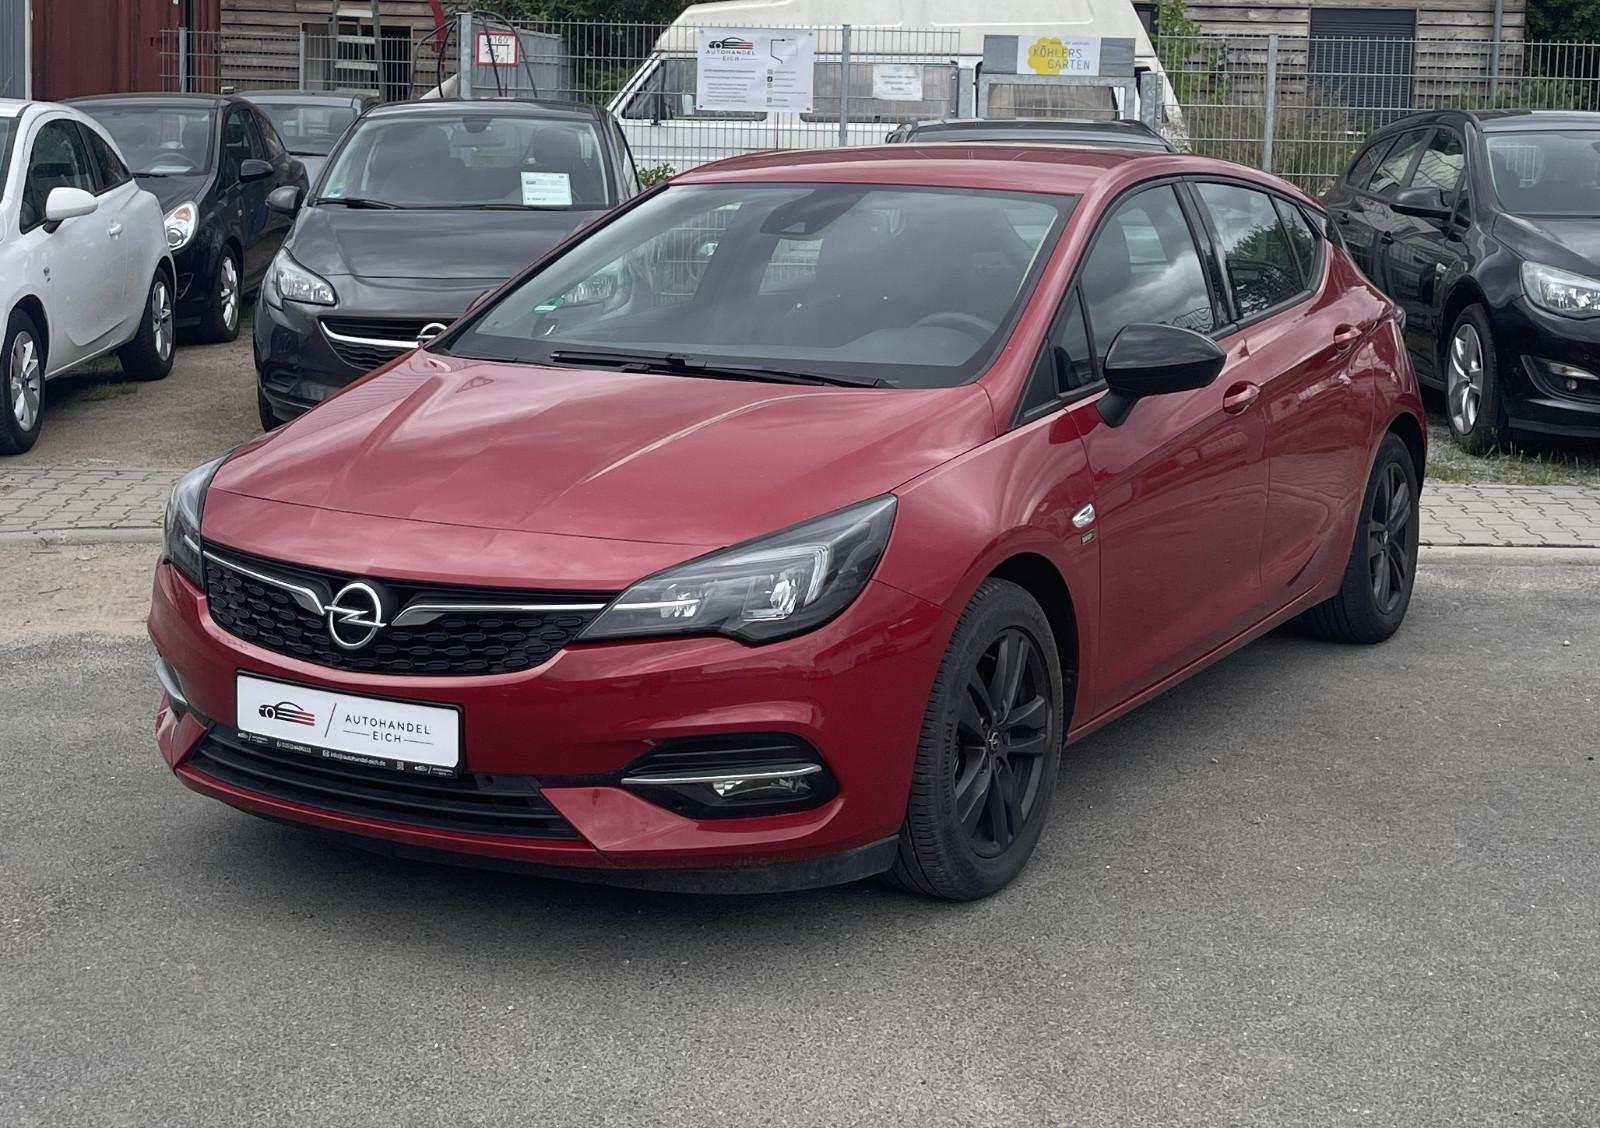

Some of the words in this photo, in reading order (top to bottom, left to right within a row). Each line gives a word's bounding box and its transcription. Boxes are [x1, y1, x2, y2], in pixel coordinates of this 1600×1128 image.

[1033, 45, 1082, 59] KÖHLERS
[1047, 59, 1090, 71] GARTEN
[345, 714, 431, 735] AUTOHANDEL
[372, 731, 401, 744] EICH
